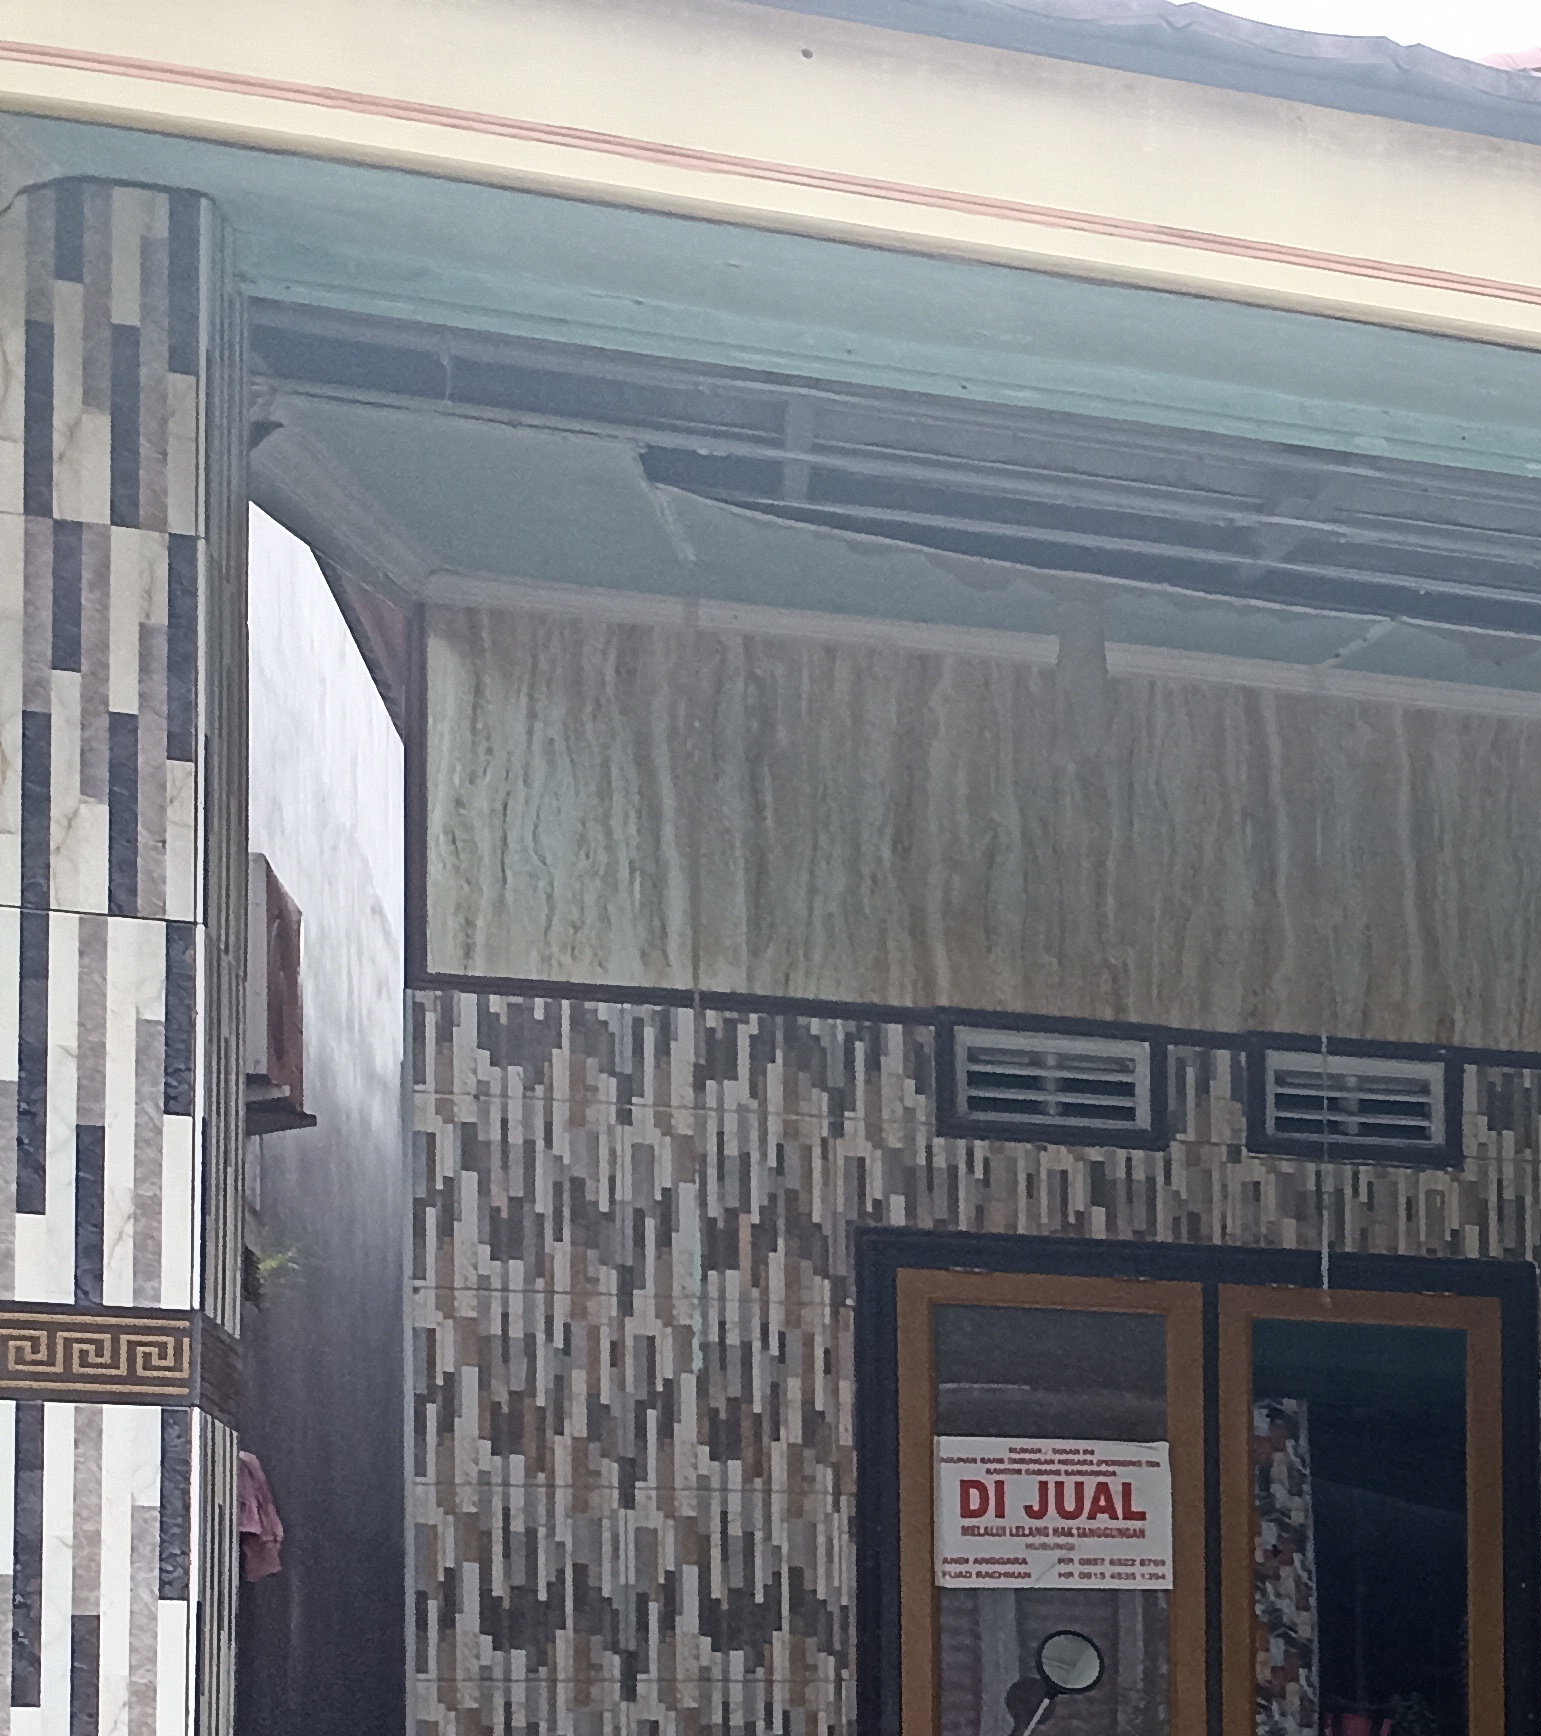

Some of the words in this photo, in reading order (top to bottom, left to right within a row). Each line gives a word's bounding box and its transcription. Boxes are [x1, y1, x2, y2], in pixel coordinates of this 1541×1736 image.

[1057, 1458, 1095, 1466] NEGARA
[985, 1467, 1023, 1476] KANTOR
[1024, 1468, 1062, 1476] CABANG
[1064, 1468, 1117, 1477] SAMARINDA
[959, 1479, 1006, 1519] DI
[1023, 1480, 1147, 1521] JUAL
[960, 1525, 1007, 1537] MELALUI
[1008, 1526, 1050, 1538] LELANG
[1052, 1526, 1075, 1538] HAK
[1076, 1527, 1146, 1539] TANGGUNGAN
[972, 1557, 1029, 1565] ANGGARA
